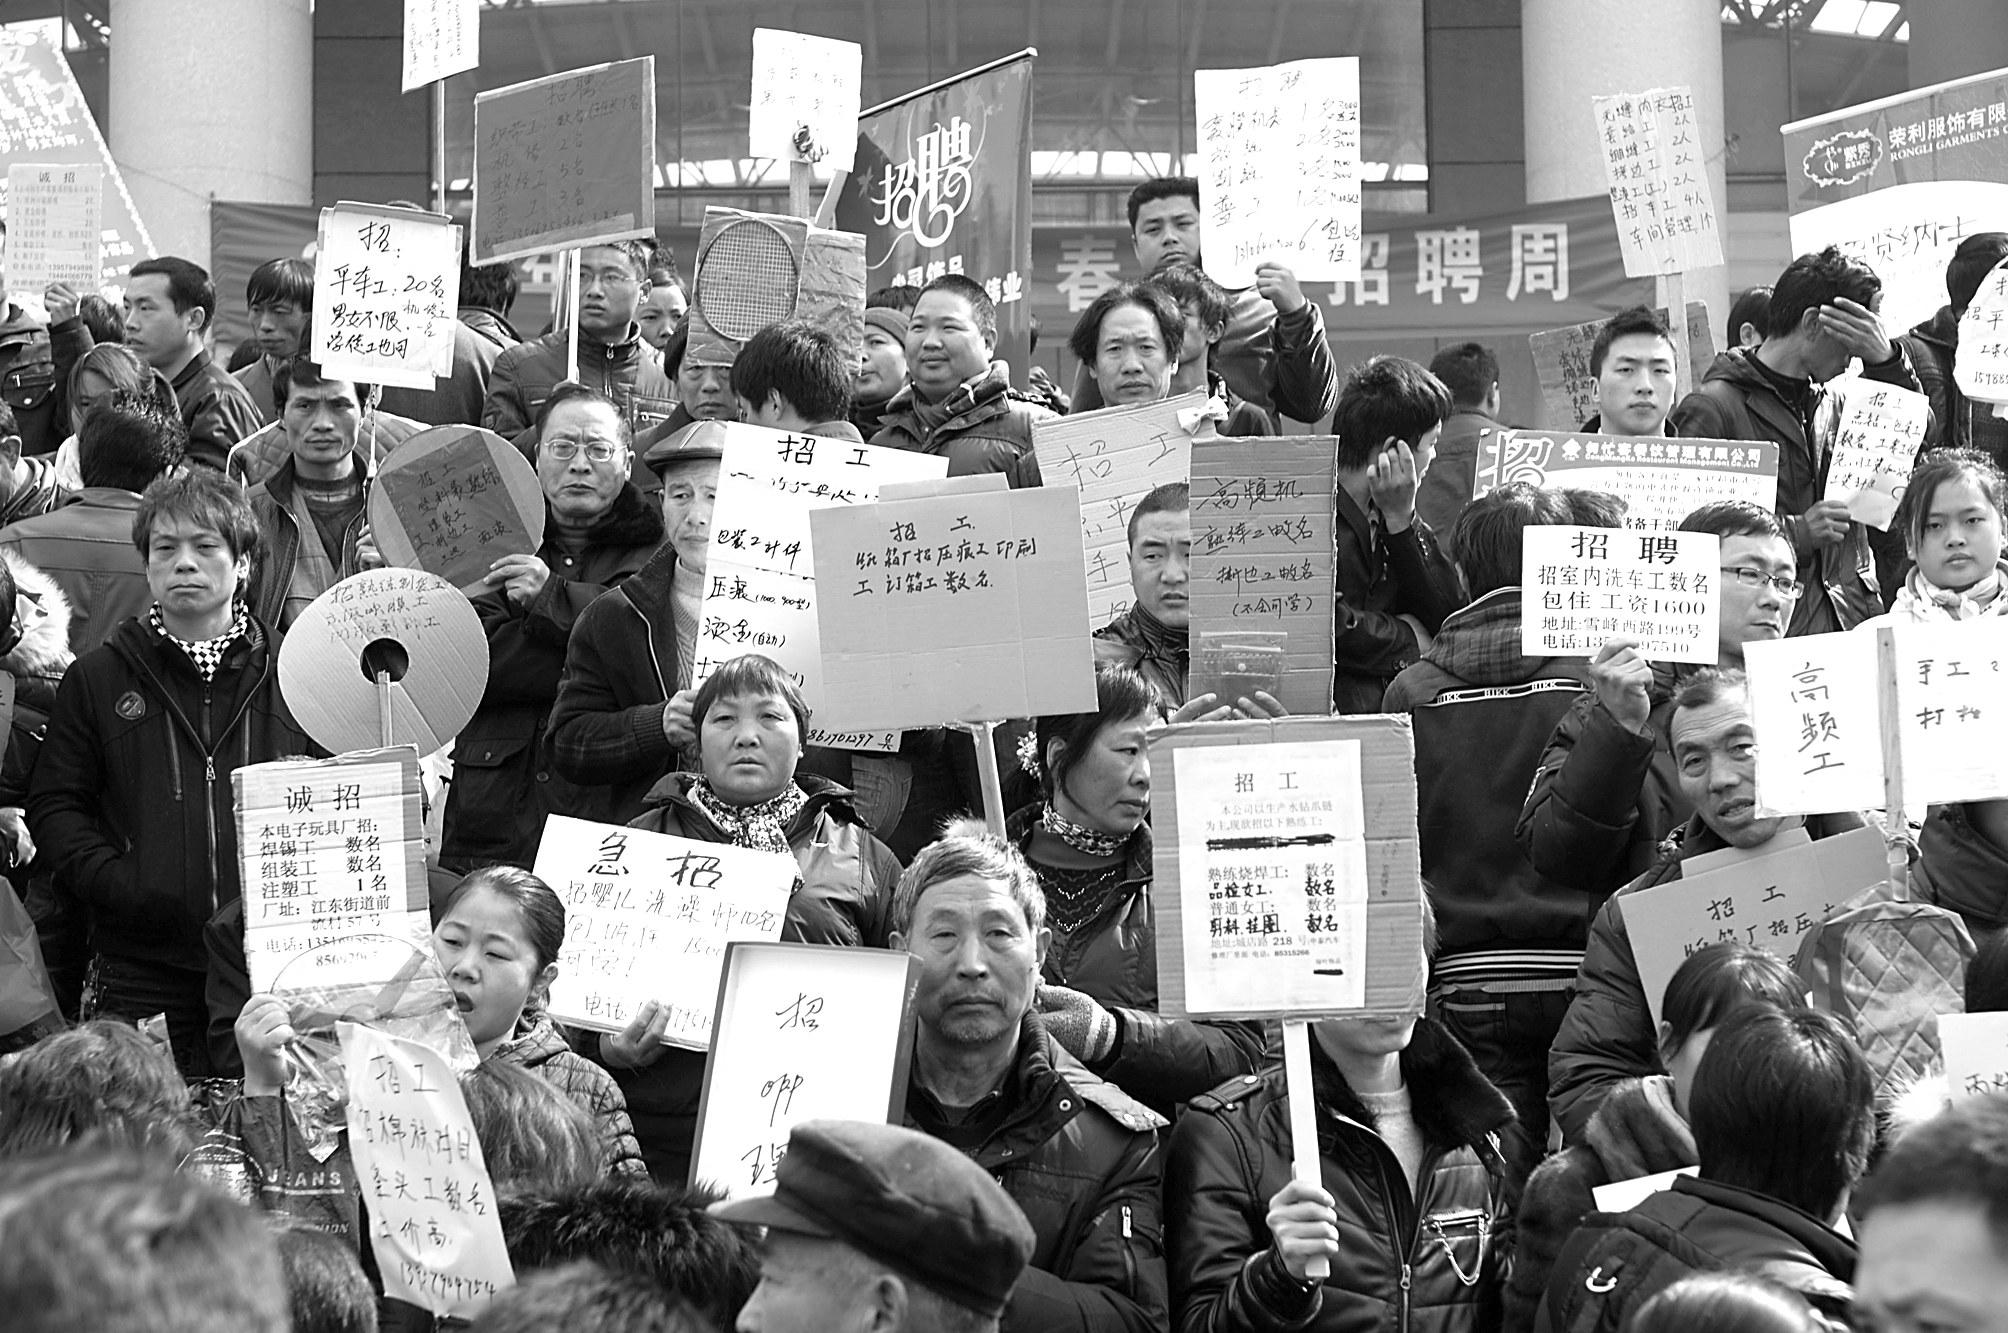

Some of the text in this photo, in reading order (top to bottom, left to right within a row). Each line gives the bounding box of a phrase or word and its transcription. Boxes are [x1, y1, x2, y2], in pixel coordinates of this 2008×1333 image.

[1888, 102, 2006, 150] 荣利服饰有限
[1890, 142, 1933, 163] RONGLI
[1936, 126, 2000, 151] GARMENTS
[777, 434, 871, 467] 招工
[1057, 431, 1176, 492] 招工
[1571, 531, 1679, 565] 招聘
[1538, 565, 1709, 594] 招室内洗车工数名
[1235, 771, 1299, 793] 招工
[283, 783, 361, 814] 诚招
[260, 818, 379, 840] 本电子玩具厂招:
[260, 834, 381, 859] 焊锡工 数名
[587, 831, 723, 890] 急招
[261, 855, 382, 879] 组装工 数名
[262, 880, 319, 900] 注塑工
[1706, 885, 1786, 921] 招工
[1272, 937, 1293, 946] 218
[776, 992, 824, 1033] 招
